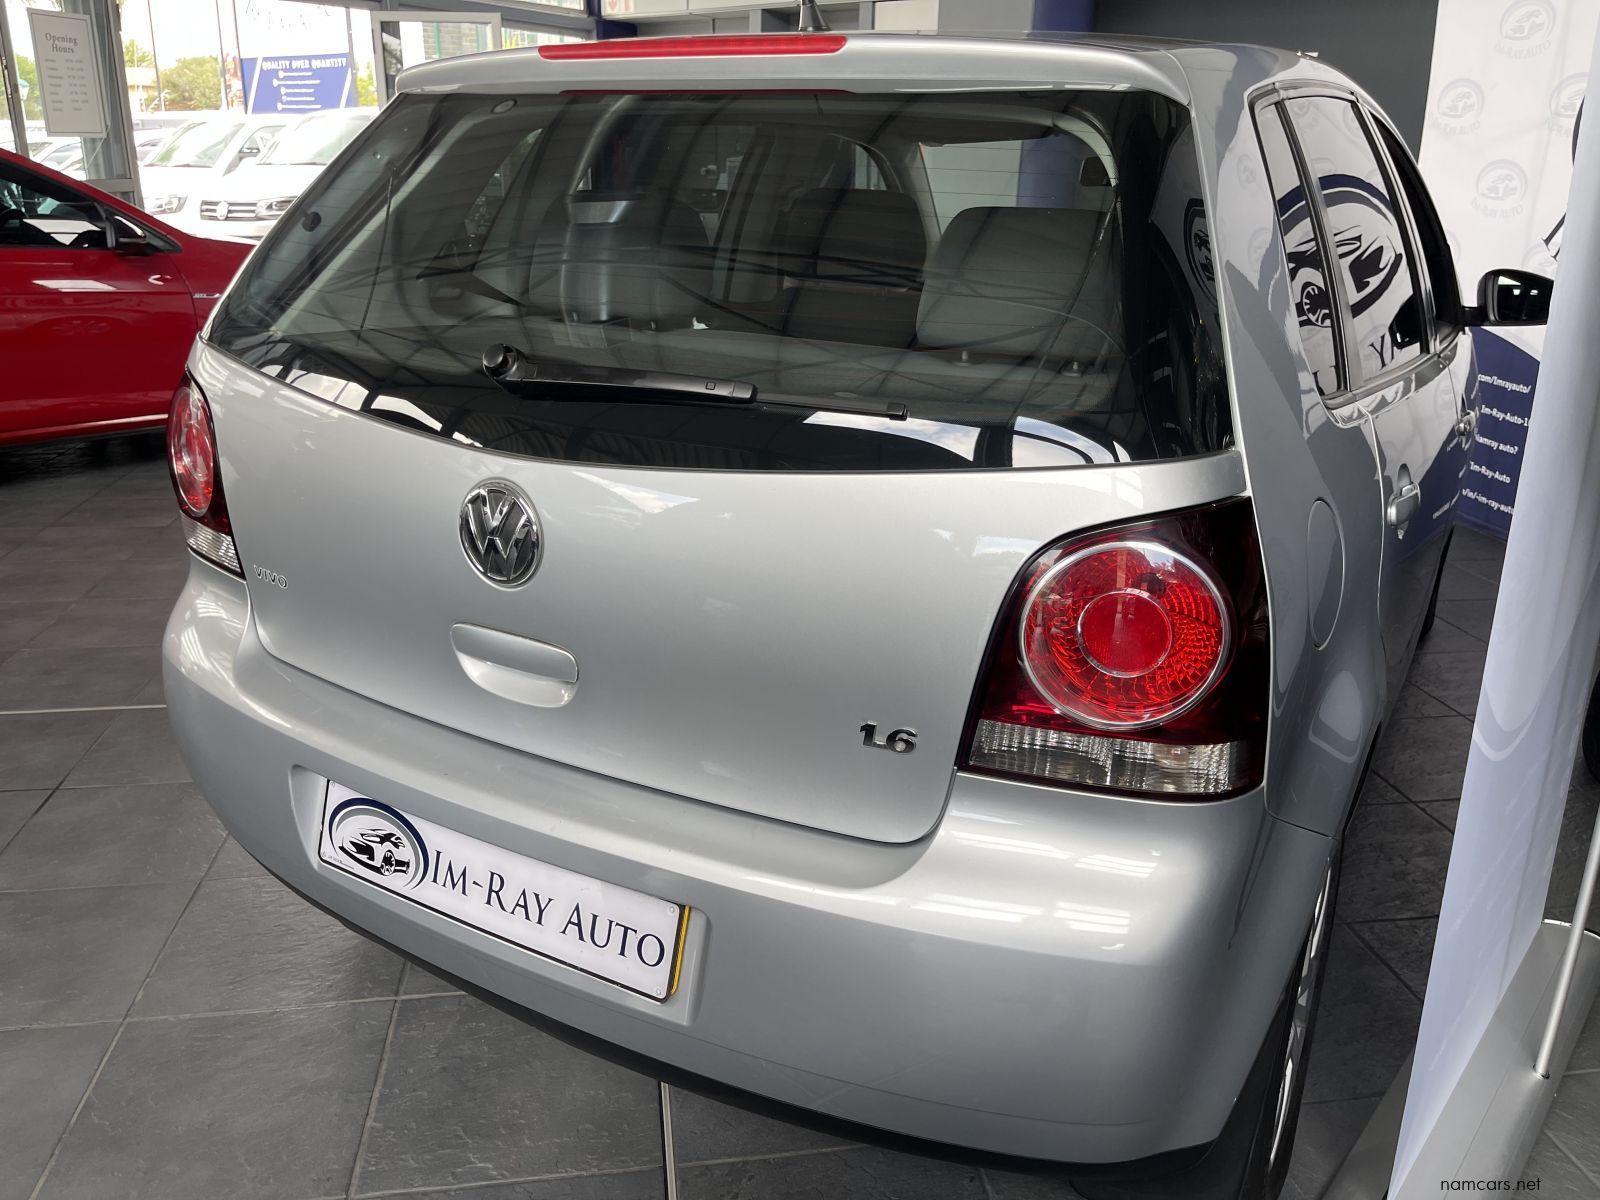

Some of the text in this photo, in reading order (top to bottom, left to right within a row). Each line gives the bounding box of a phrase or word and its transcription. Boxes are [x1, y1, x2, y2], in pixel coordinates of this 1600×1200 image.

[44, 32, 79, 47] Opening
[51, 43, 76, 54] Hours
[262, 57, 347, 71] QUALITY OVER QUANTITY
[253, 564, 288, 589] VIVO
[859, 720, 919, 754] 1.6
[559, 902, 667, 968] AUTO
